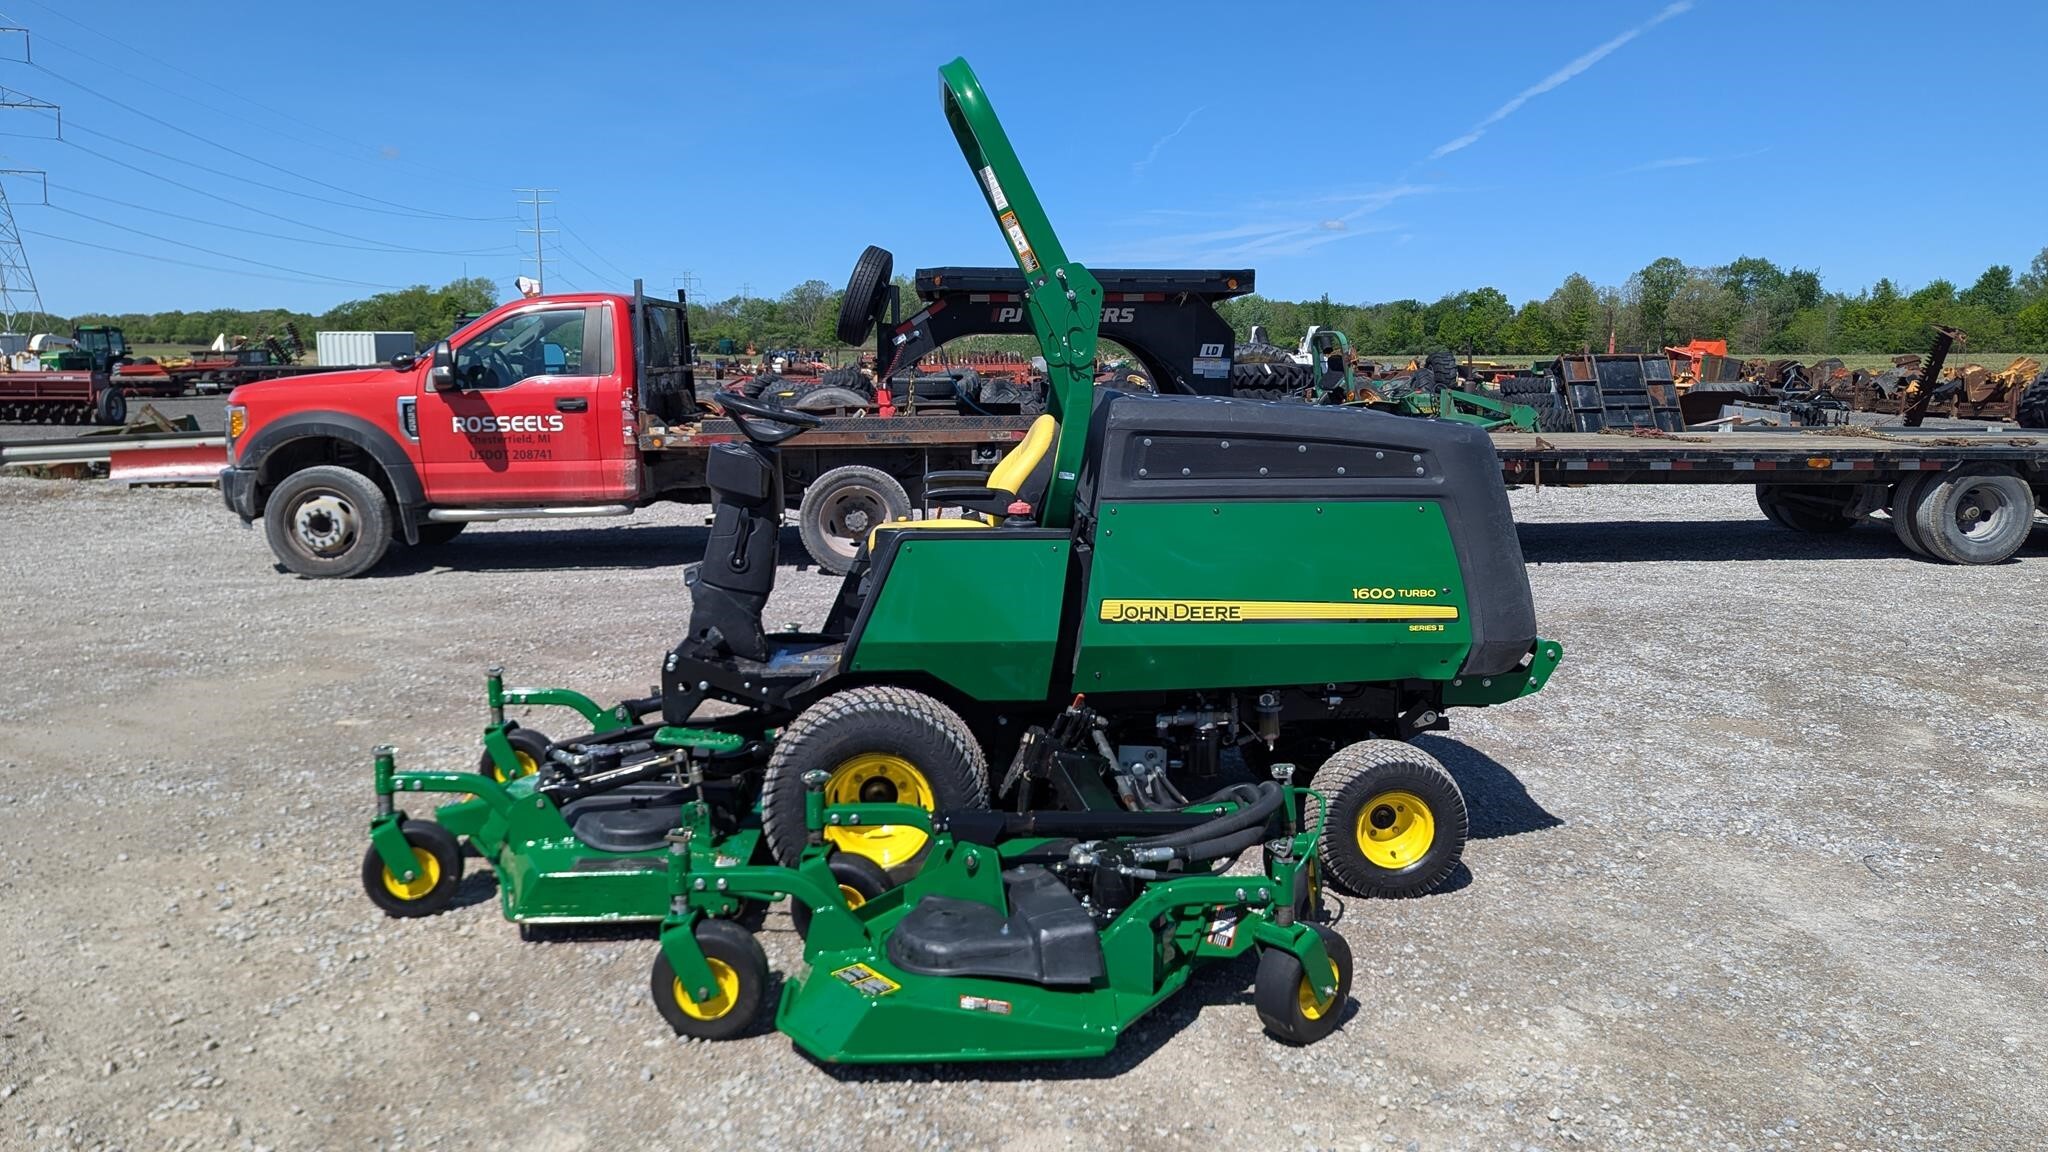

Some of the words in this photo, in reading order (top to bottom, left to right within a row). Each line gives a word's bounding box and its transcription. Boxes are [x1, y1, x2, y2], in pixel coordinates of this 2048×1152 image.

[998, 307, 1023, 323] PJ
[1206, 346, 1219, 355] LD
[452, 415, 564, 432] ROSSEEL'S
[538, 434, 551, 444] MI
[469, 449, 509, 460] USDOT
[512, 449, 553, 460] 208741
[1352, 588, 1395, 599] 1600
[1398, 589, 1436, 599] TURBO
[1113, 604, 1168, 619] JOHN
[1173, 604, 1241, 619] DEERE
